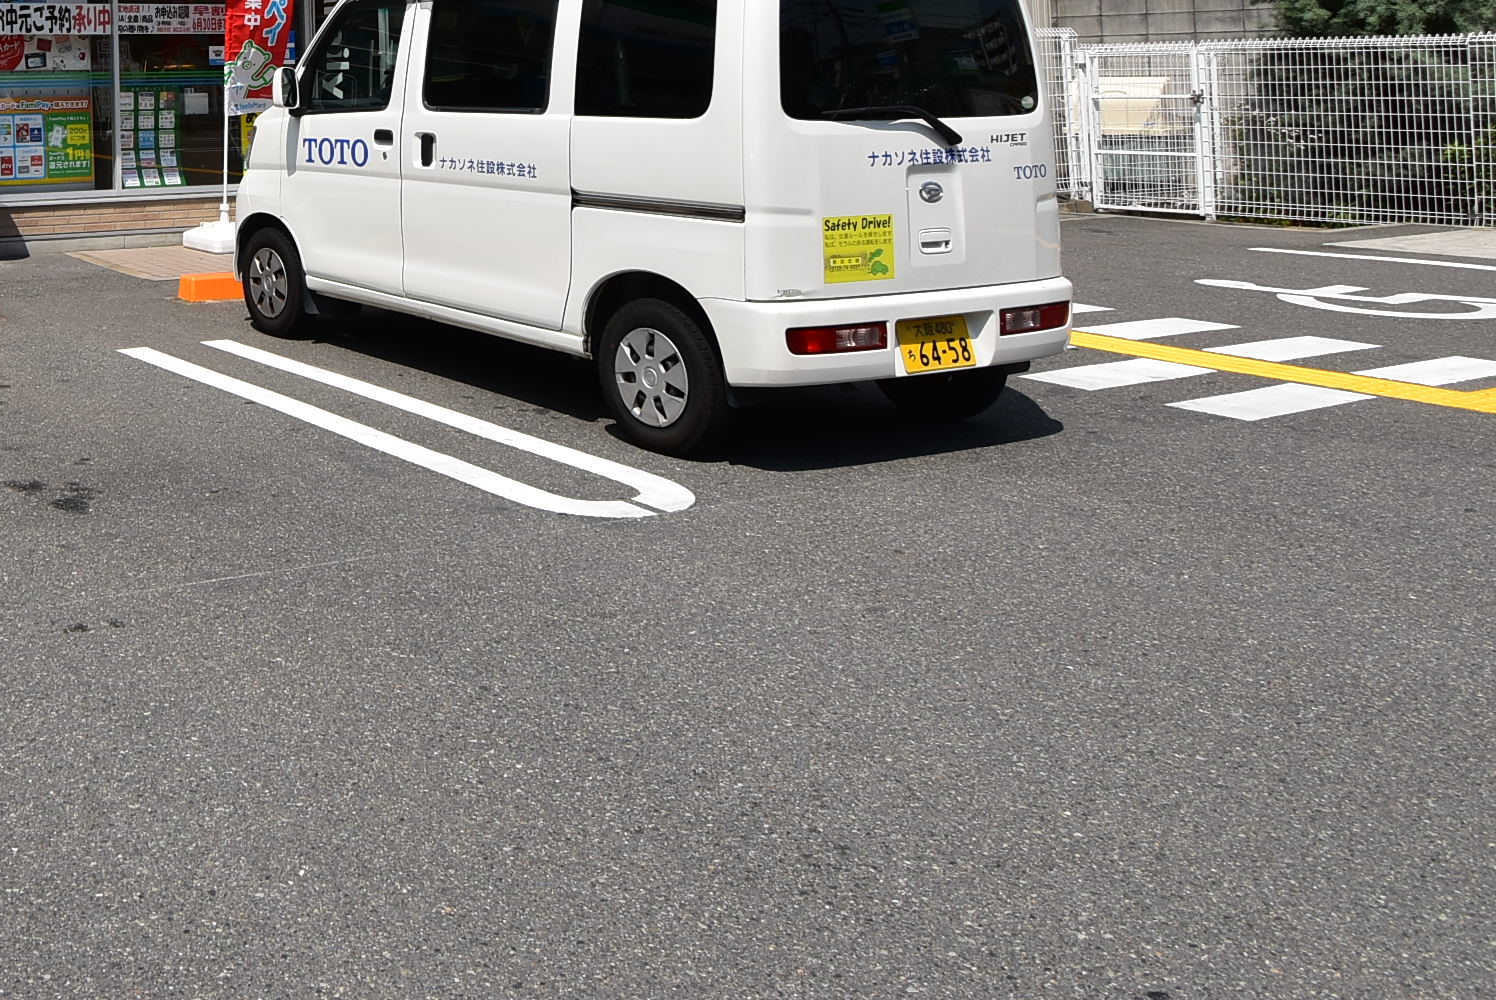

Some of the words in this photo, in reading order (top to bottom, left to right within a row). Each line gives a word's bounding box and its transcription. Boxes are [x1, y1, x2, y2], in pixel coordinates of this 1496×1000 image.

[990, 133, 1026, 144] HIJET
[303, 137, 368, 167] TOTO
[868, 146, 992, 168] ナカソネ住設株式会社
[439, 157, 537, 178] ナカソネ住設株式会社
[1013, 164, 1047, 180] TOTO
[824, 218, 858, 232] Safety
[861, 215, 891, 230] Drive!
[912, 320, 953, 338] 大阪480
[907, 349, 916, 362] ち
[919, 336, 971, 367] 64-58
